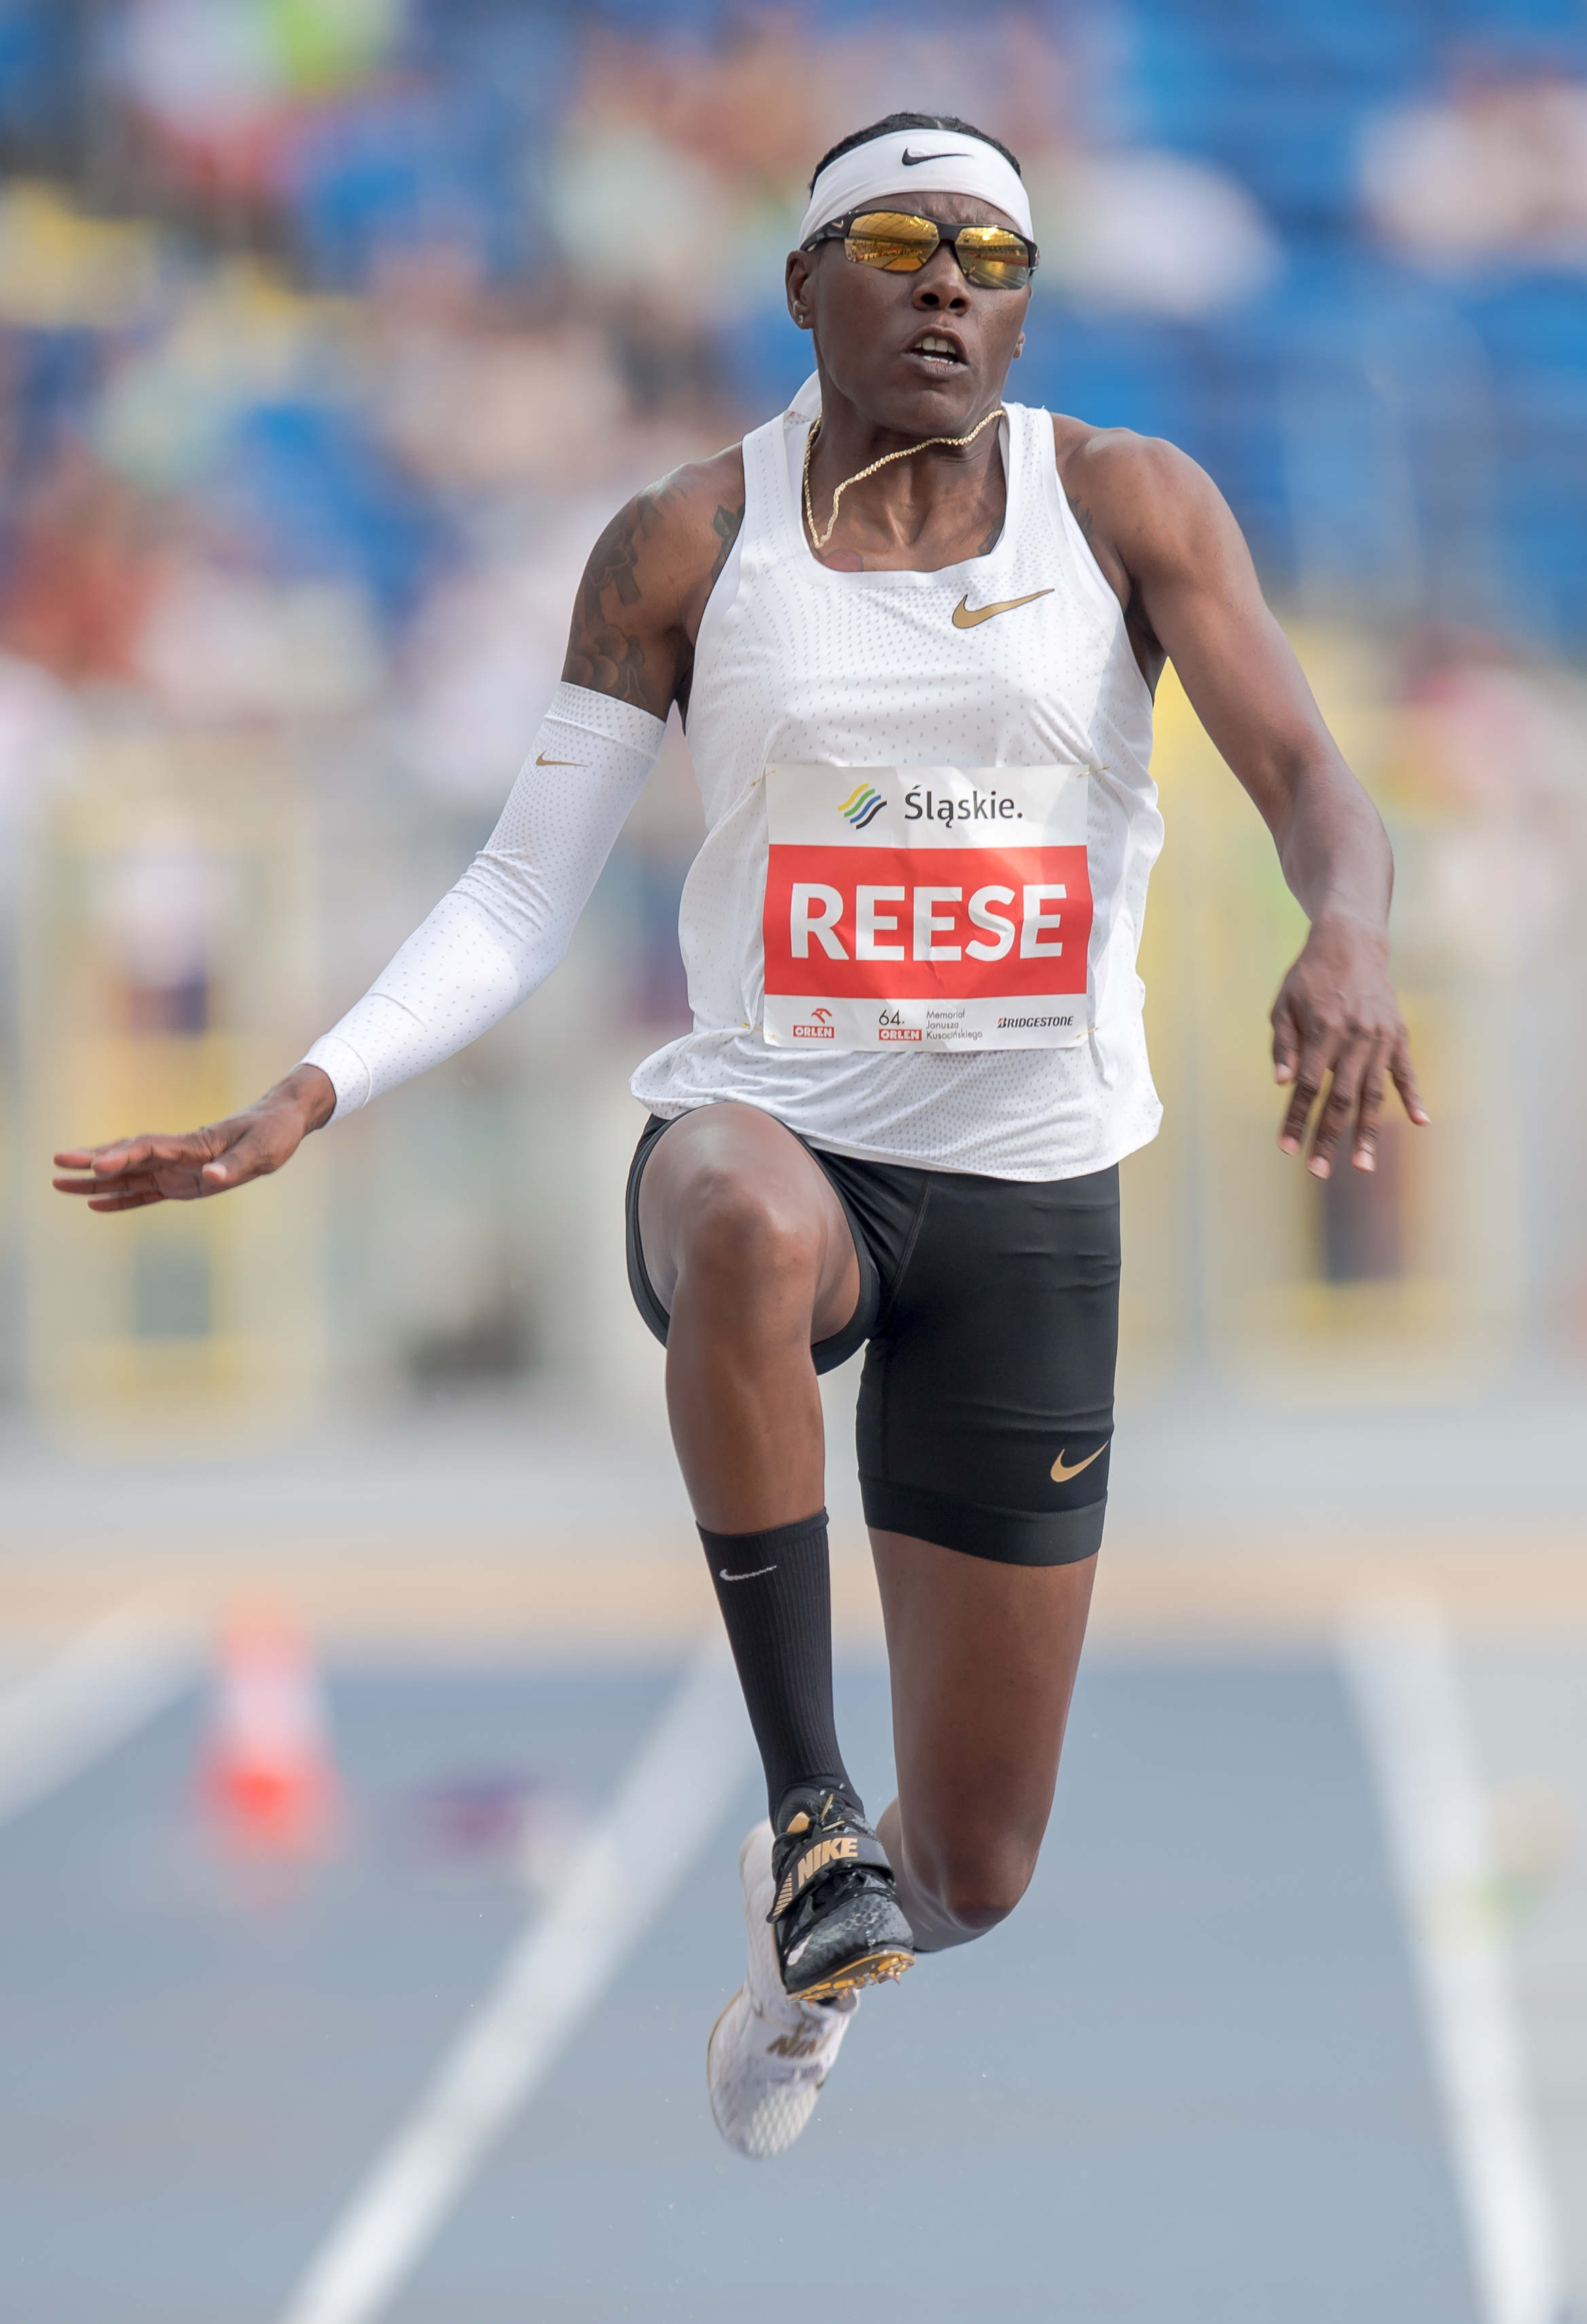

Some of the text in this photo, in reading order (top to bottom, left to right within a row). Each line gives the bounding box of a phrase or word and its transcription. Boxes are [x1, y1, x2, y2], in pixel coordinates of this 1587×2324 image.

[905, 784, 1023, 828] Śląskie.
[790, 883, 1067, 962] REESE
[879, 1009, 905, 1025] 64.
[997, 1016, 1074, 1029] BRIDGESTONE
[795, 1026, 833, 1037] ORLEN
[926, 1021, 959, 1029] Janusza
[881, 1030, 919, 1040] ORLEN
[926, 1029, 983, 1040] Kusocińskiego
[797, 1837, 858, 1889] NIKE
